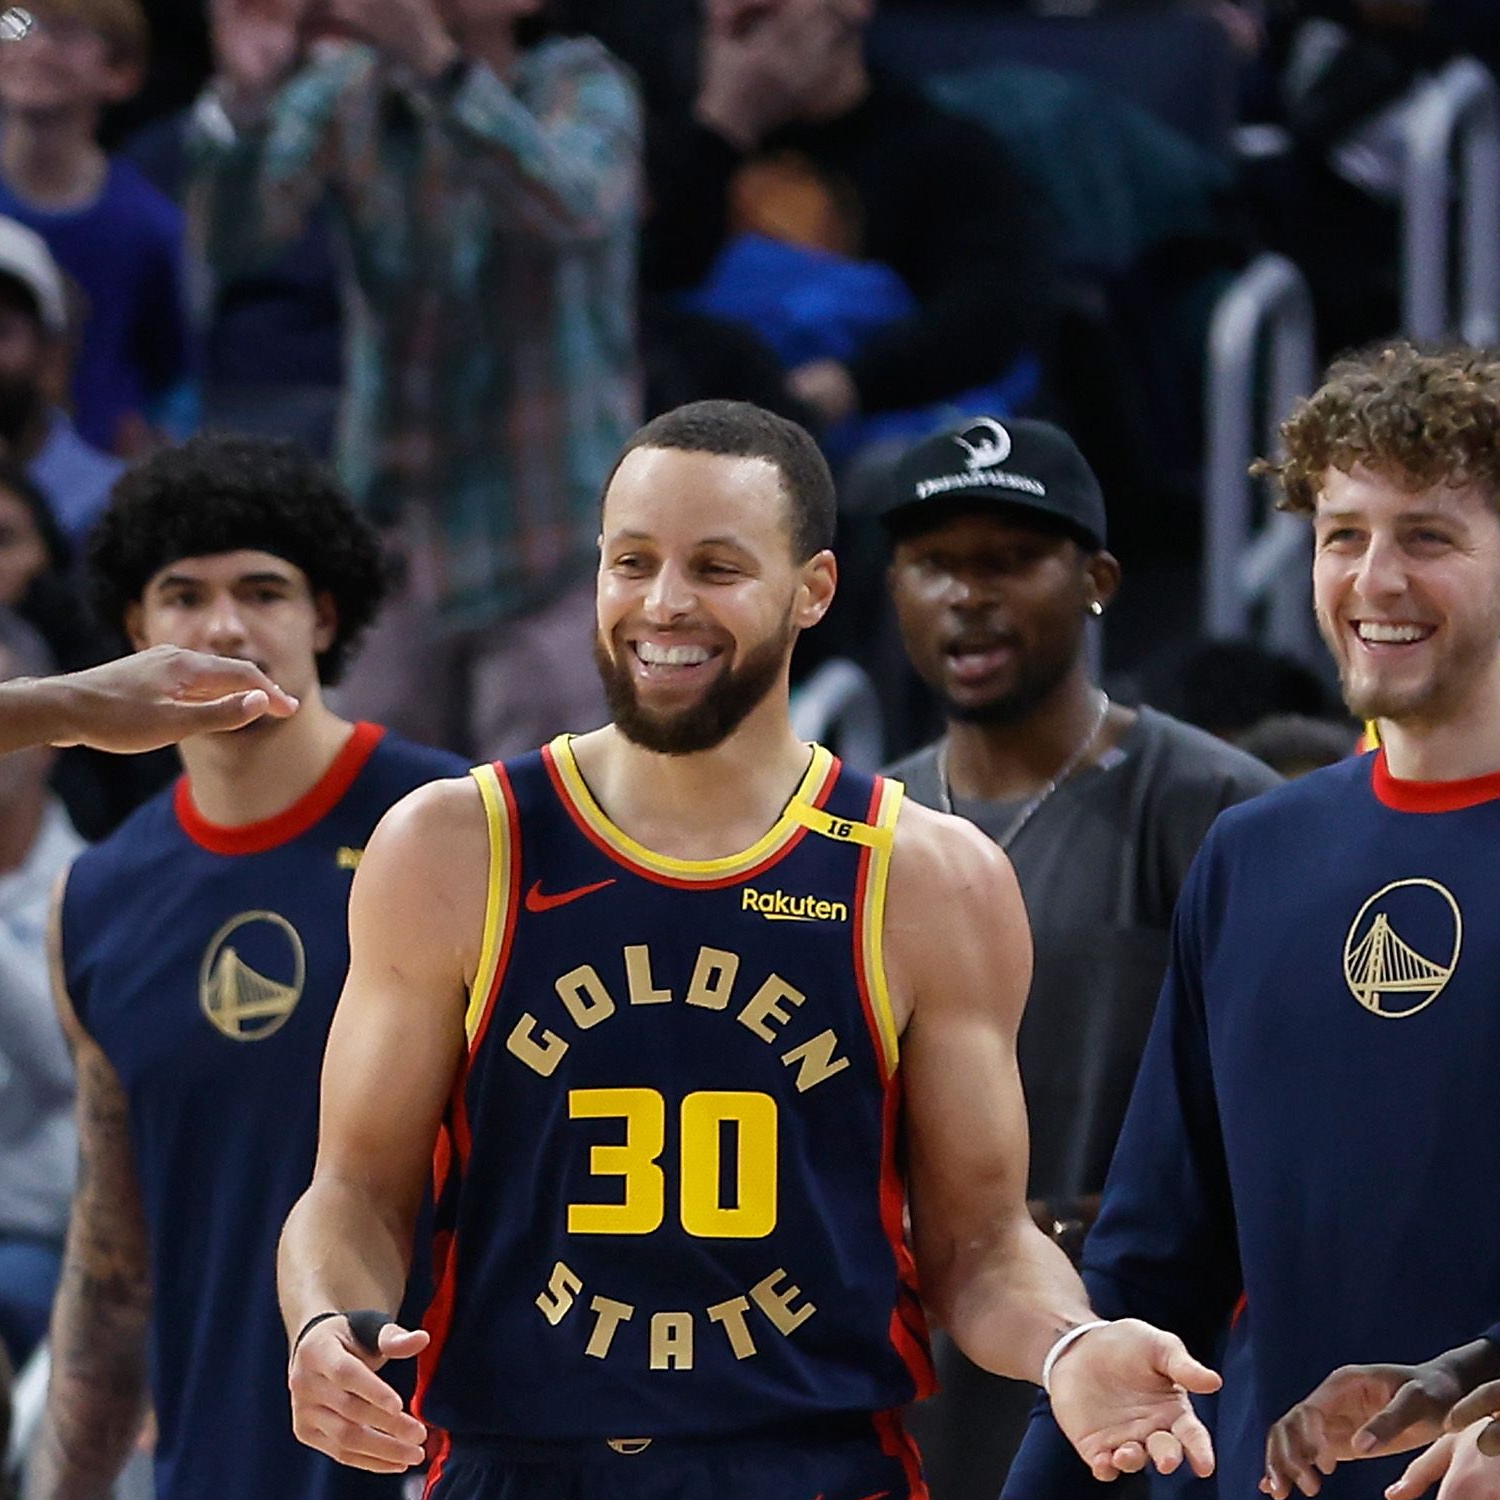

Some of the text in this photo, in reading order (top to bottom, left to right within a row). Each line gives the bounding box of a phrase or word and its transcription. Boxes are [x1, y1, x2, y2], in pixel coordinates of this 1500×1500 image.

[826, 819, 853, 838] 16
[741, 887, 848, 922] Rakuten
[506, 943, 851, 1094] GOLDEN
[567, 1087, 778, 1239] 30
[534, 1260, 818, 1371] STATE
